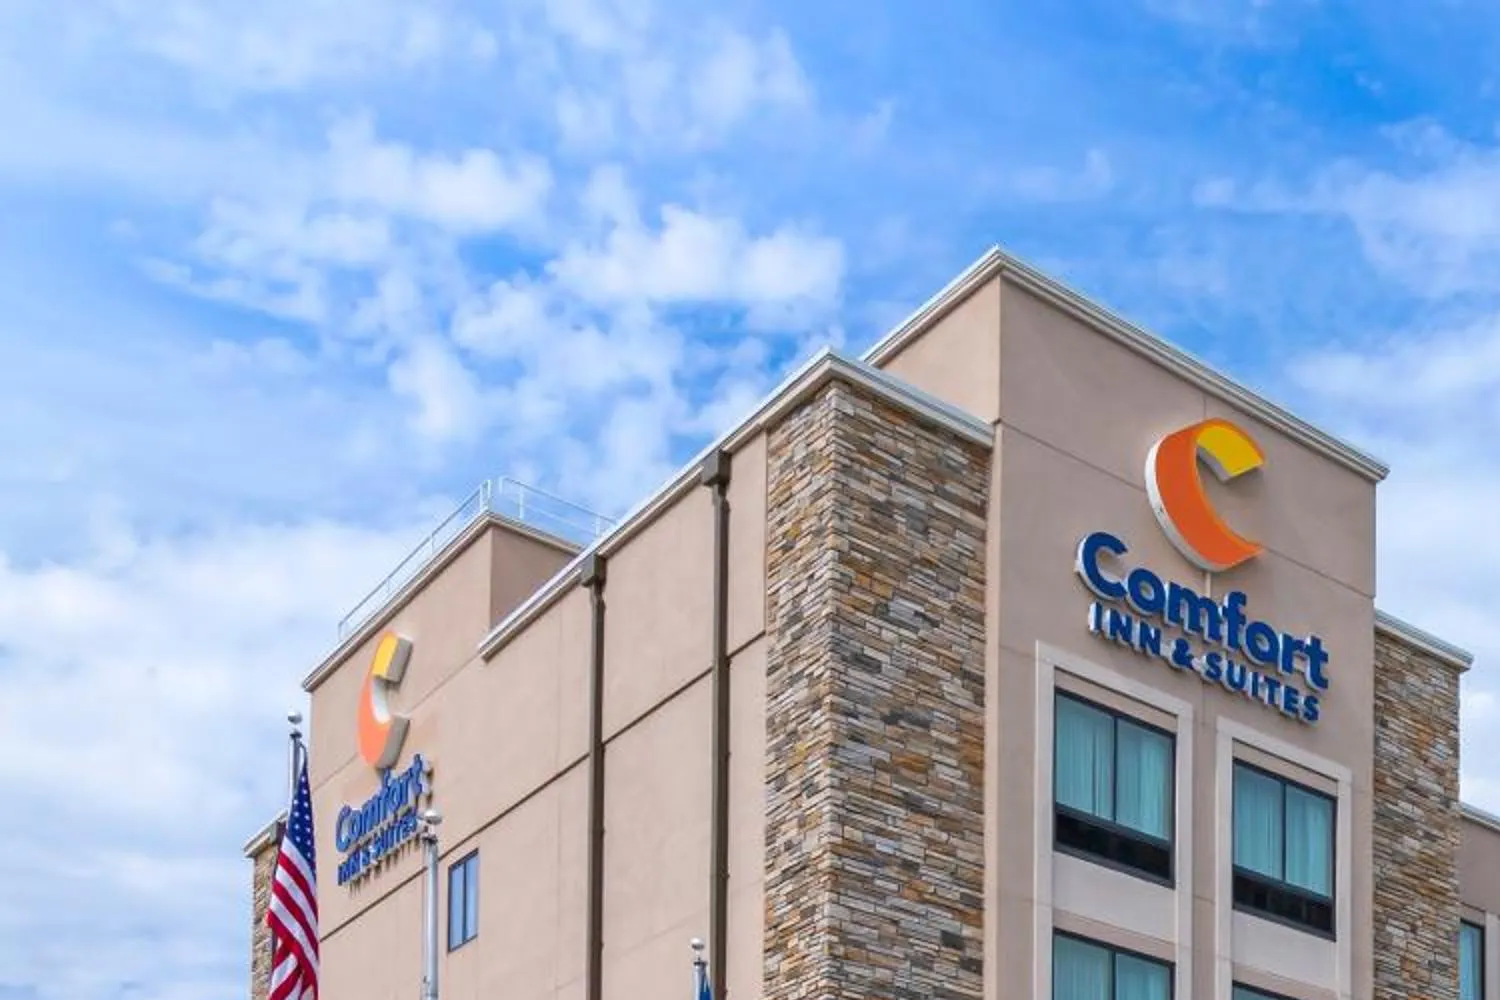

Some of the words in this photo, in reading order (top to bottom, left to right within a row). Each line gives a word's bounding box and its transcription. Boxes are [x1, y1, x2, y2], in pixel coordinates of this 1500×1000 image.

[1079, 531, 1329, 690] Comfort
[1090, 602, 1162, 656] INN
[1171, 639, 1202, 671] &
[1203, 650, 1321, 724] SUITES
[335, 753, 424, 852] Comfort
